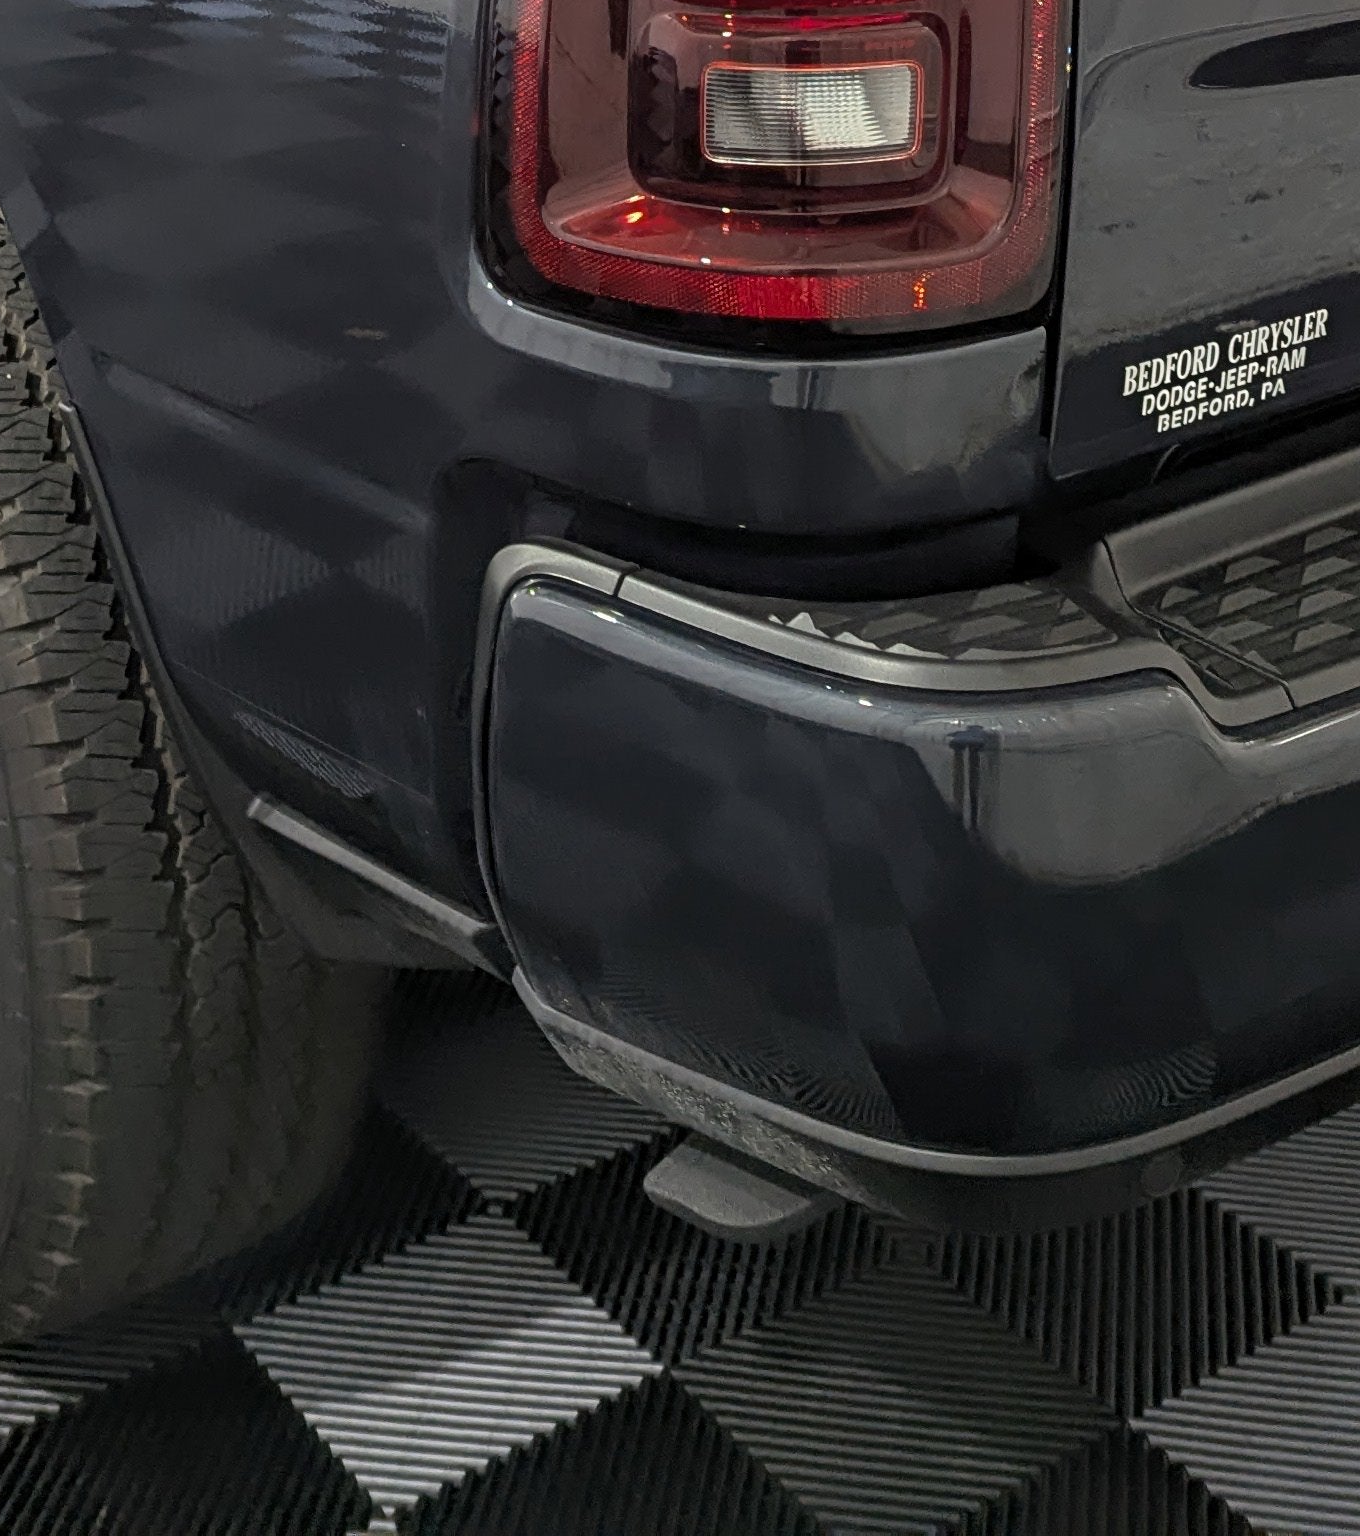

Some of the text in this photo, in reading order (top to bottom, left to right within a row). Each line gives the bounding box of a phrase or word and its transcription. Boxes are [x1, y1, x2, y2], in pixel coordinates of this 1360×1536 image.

[1122, 308, 1328, 397] BEDFORD CHRYSLER
[1156, 378, 1286, 433] BEDFORD, PA
